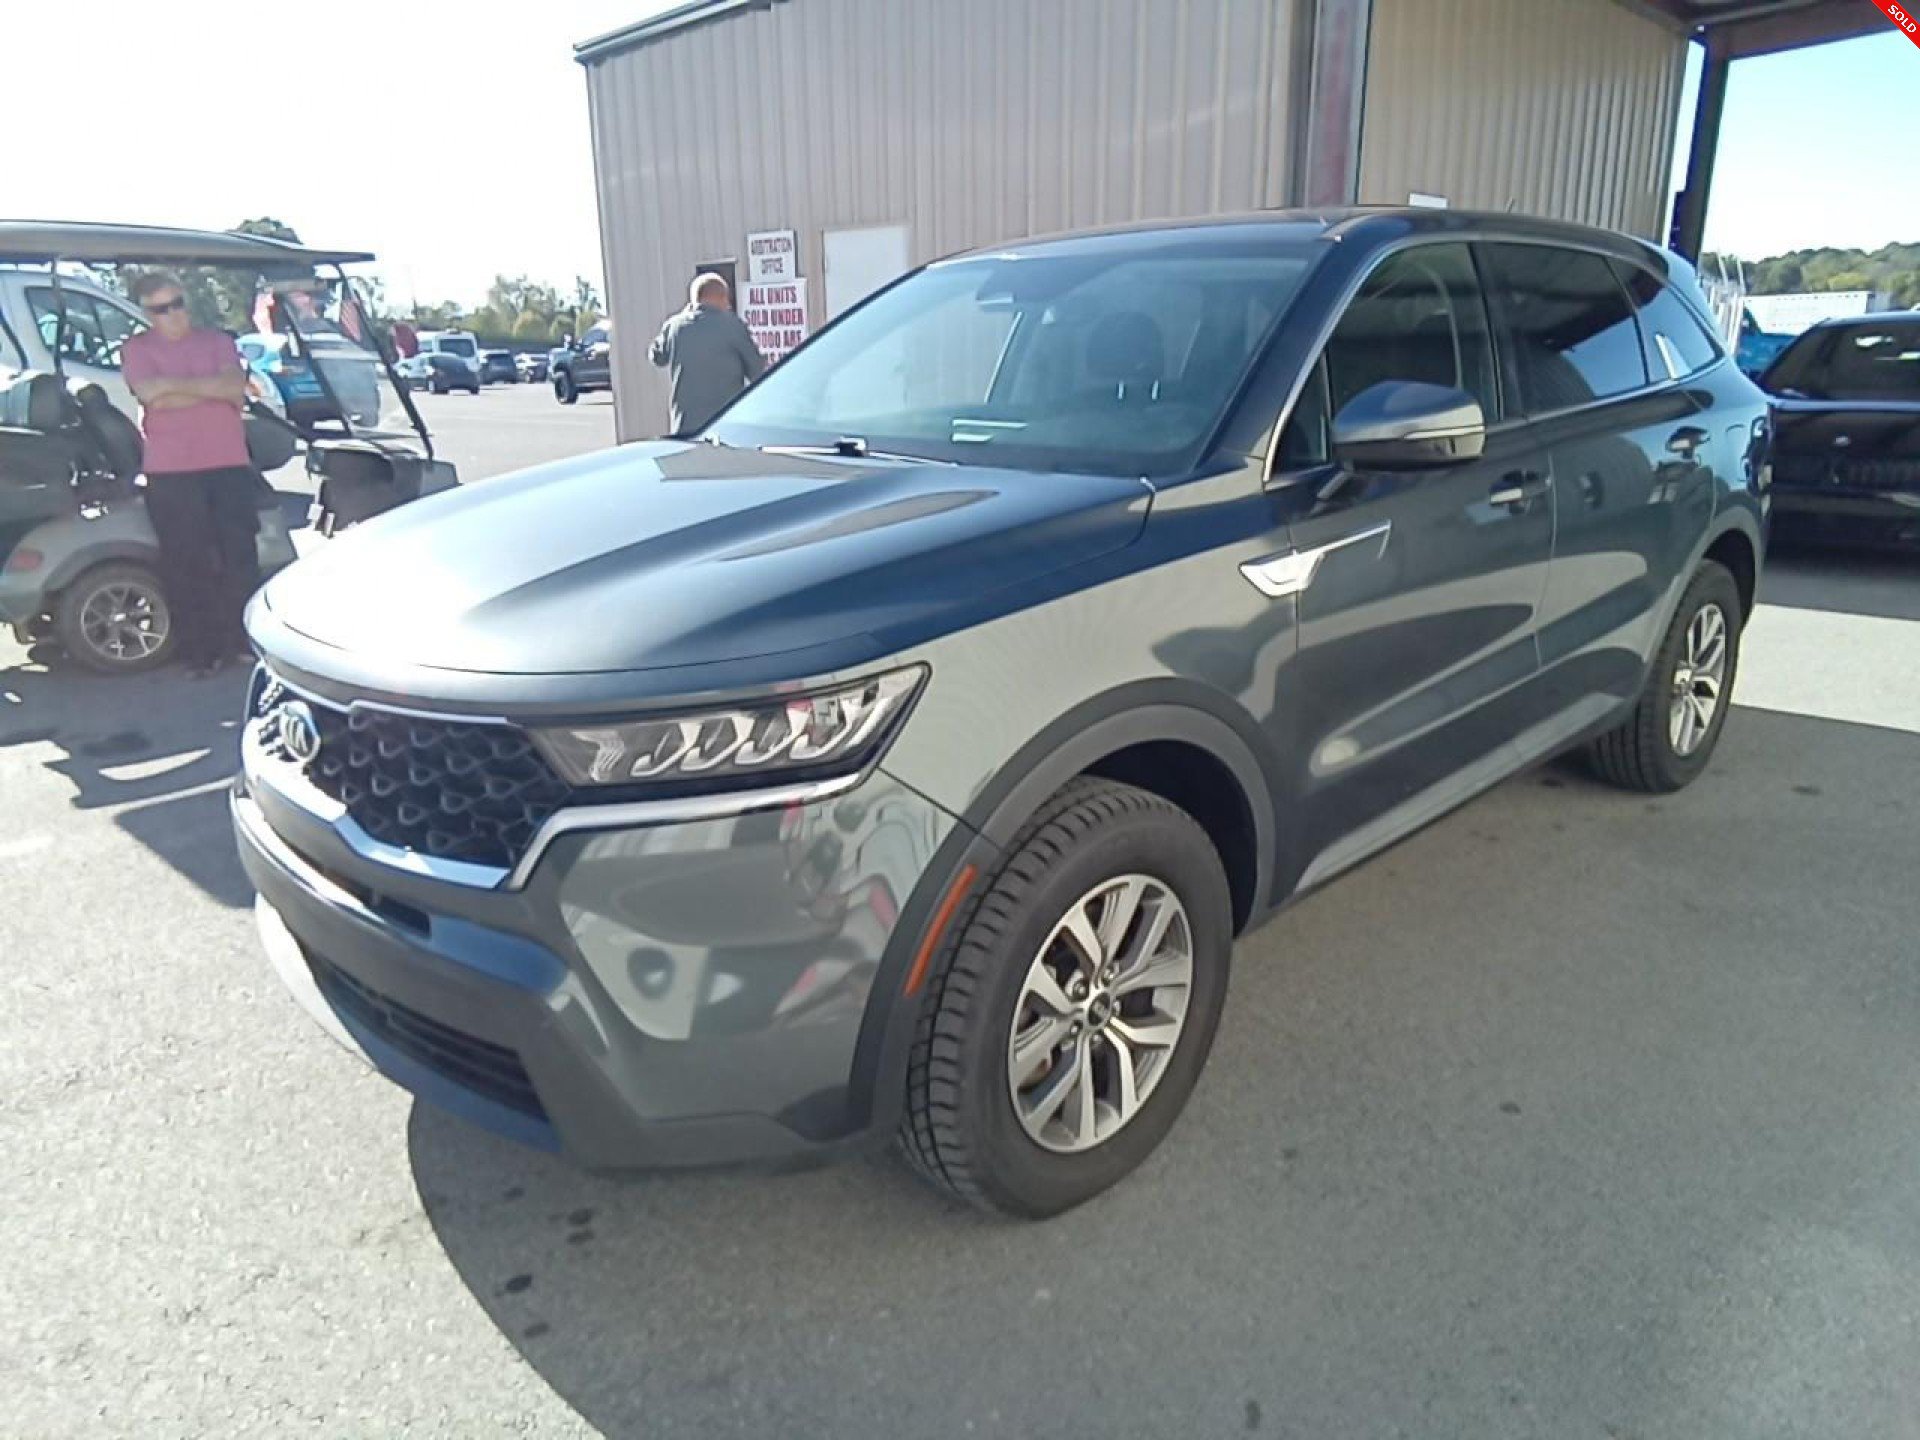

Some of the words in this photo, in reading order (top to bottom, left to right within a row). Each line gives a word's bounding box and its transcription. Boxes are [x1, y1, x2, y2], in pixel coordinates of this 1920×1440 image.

[751, 238, 792, 255] ARBITRATION
[761, 257, 784, 274] OFFICE
[749, 287, 765, 305] ALL
[768, 286, 797, 304] UNITS
[744, 309, 769, 326] SOLD
[771, 308, 804, 325] UNDER
